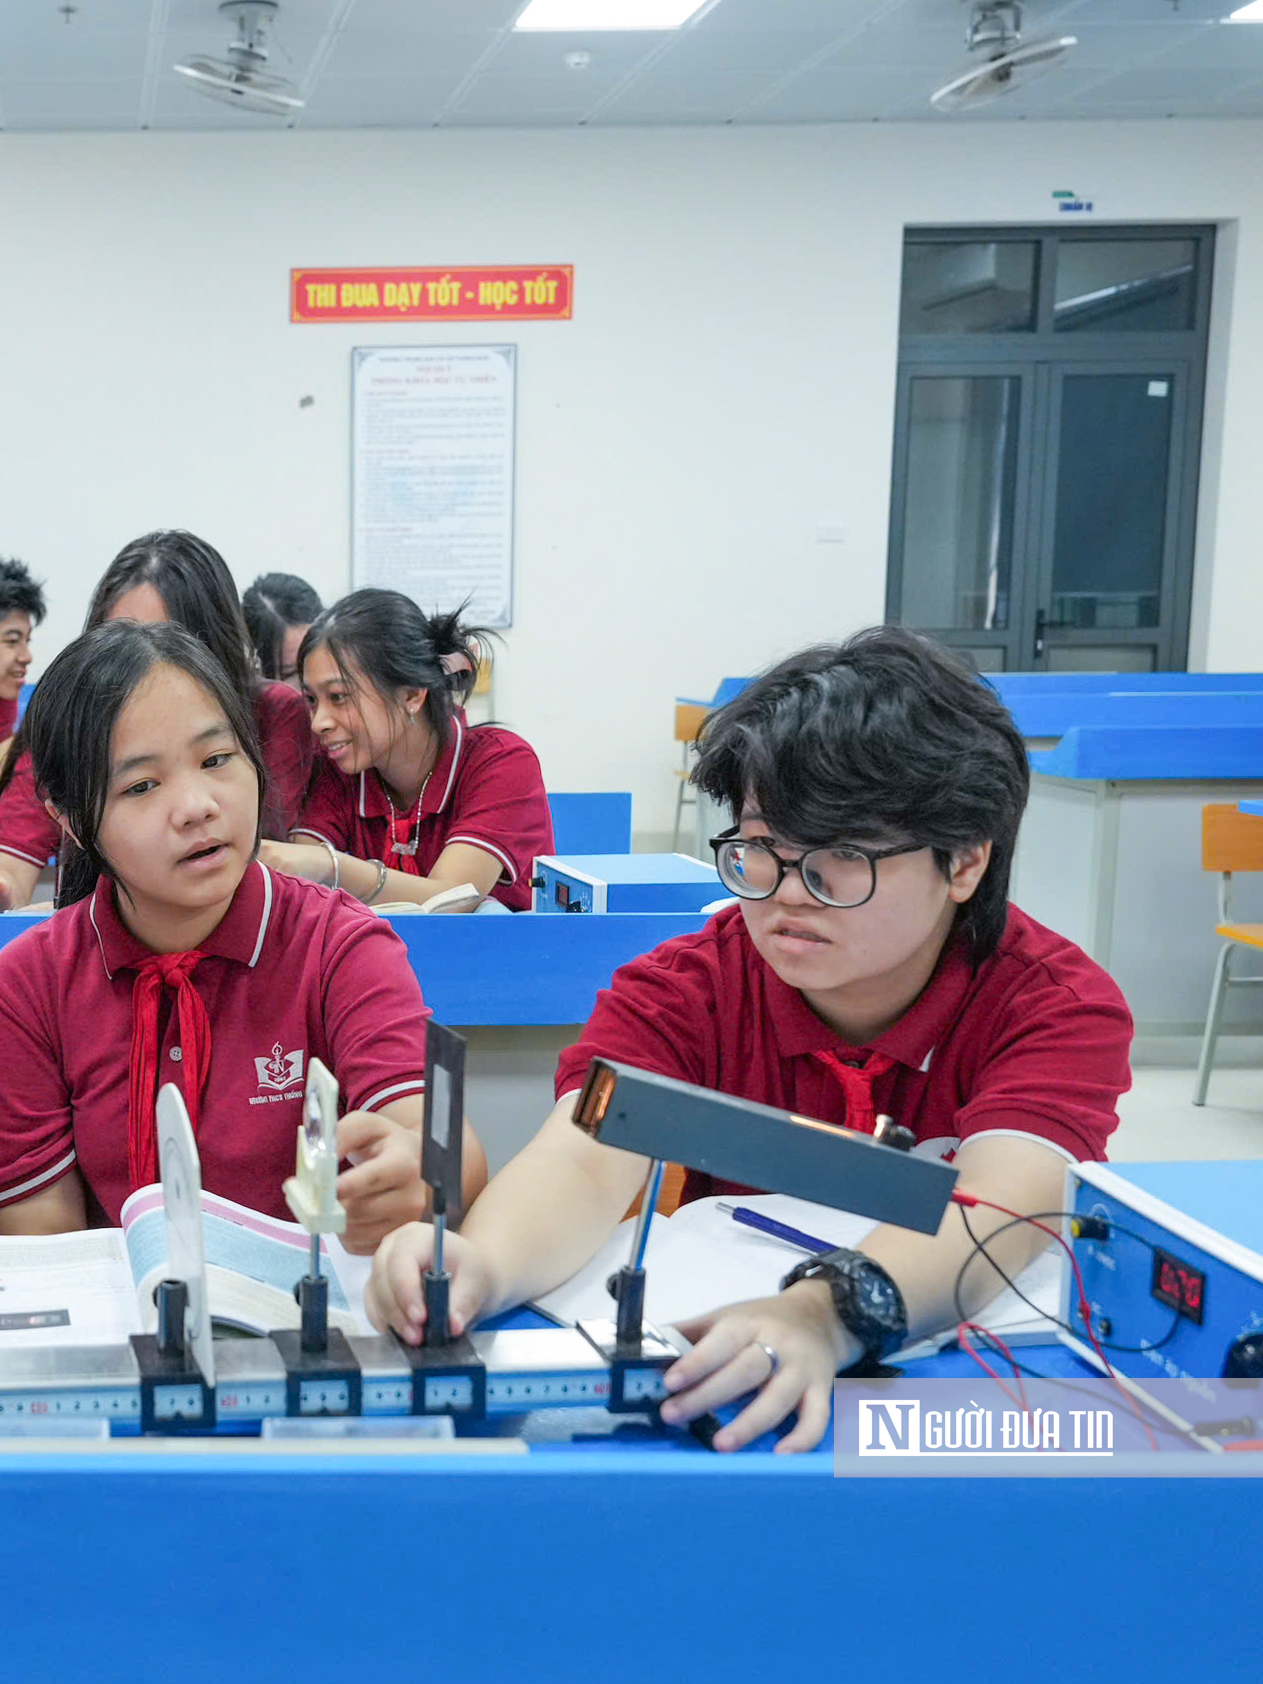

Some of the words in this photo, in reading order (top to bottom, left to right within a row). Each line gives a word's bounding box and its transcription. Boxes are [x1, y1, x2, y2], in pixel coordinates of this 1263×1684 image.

[306, 283, 337, 307] THI
[340, 283, 379, 307] ĐUA
[384, 283, 423, 311] DẠY
[426, 273, 461, 306] TỐT
[465, 291, 474, 300] -
[478, 281, 519, 311] HỌC
[523, 272, 558, 305] TỐT
